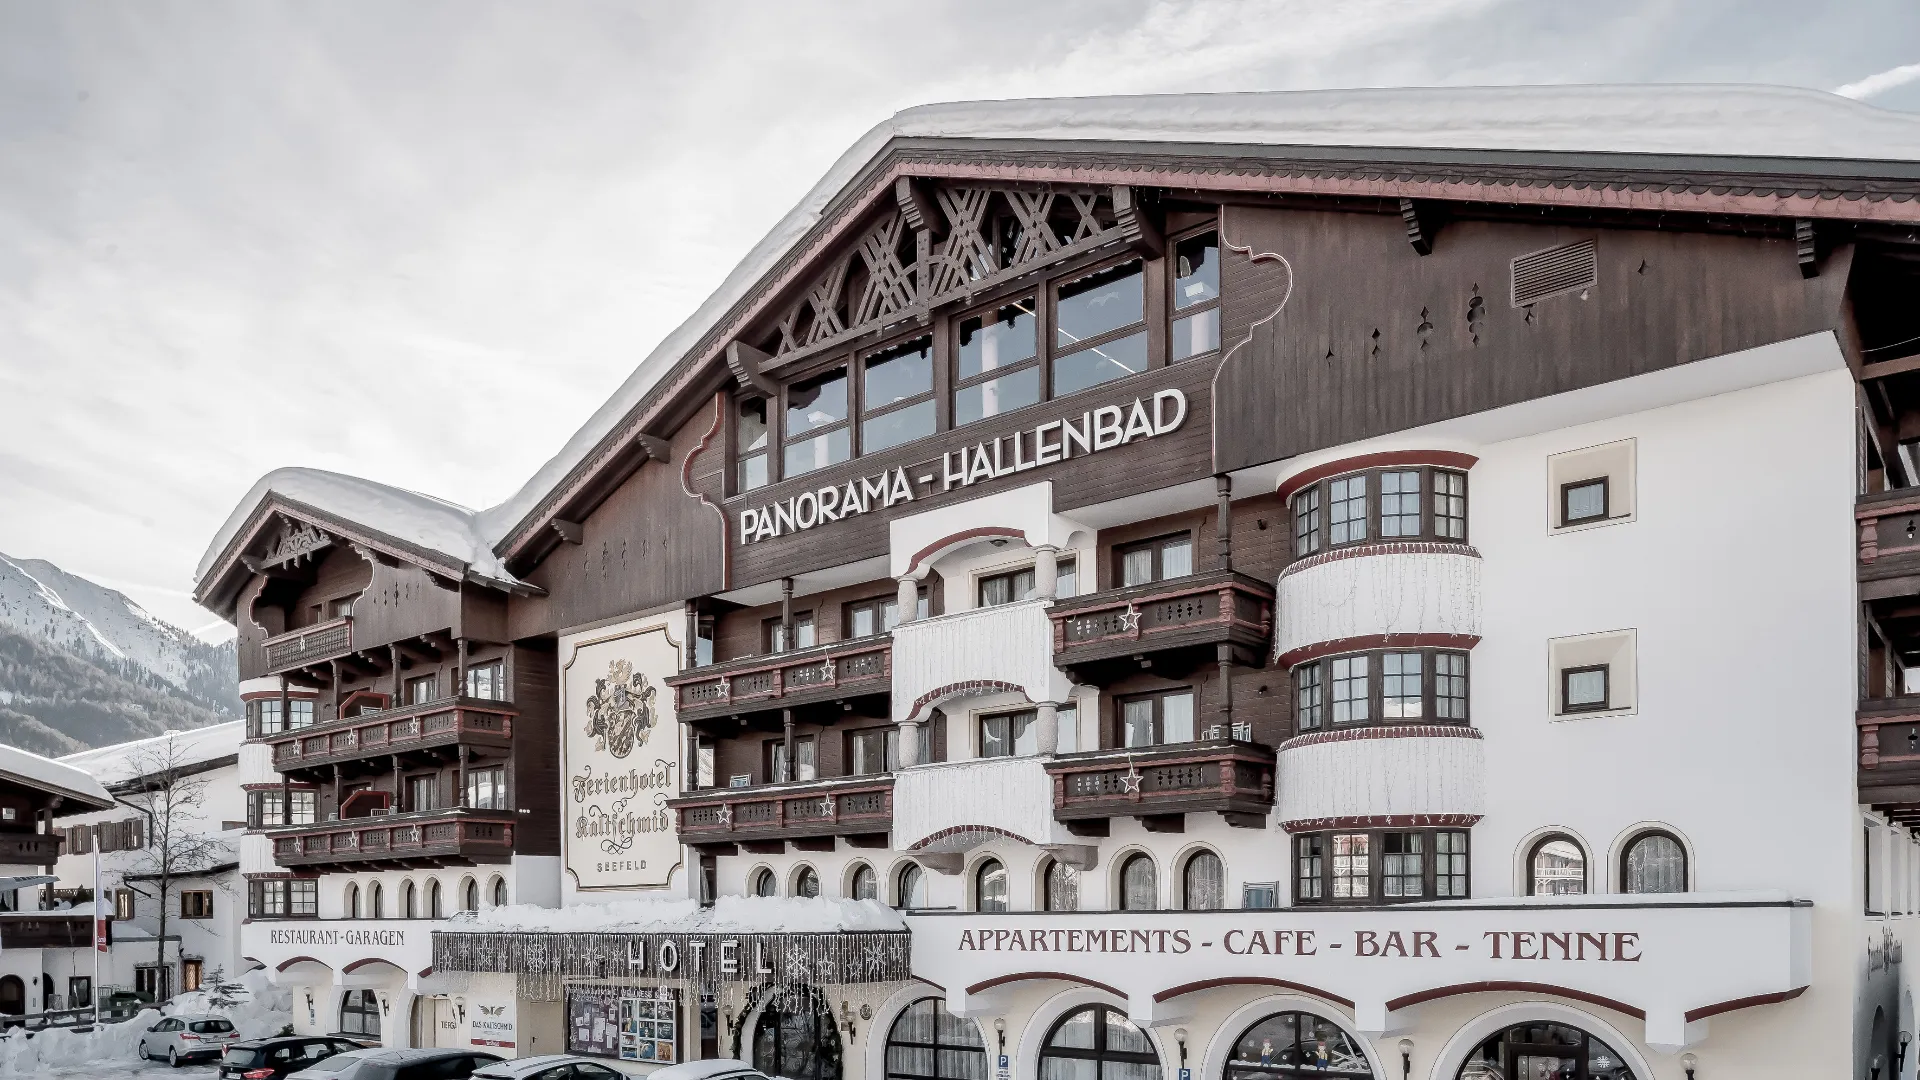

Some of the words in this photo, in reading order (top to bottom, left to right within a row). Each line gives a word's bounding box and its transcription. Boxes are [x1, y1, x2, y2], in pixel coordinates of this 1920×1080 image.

[740, 465, 914, 545] PANORAMA
[943, 388, 1188, 491] HALLENBAD
[572, 759, 676, 807] Ferienhotel
[597, 860, 647, 873] SEEFELD
[627, 939, 772, 974] HOTEL
[958, 929, 1192, 954] APPARTEMENTS
[1223, 929, 1318, 956] CAFE
[1354, 930, 1442, 958] BAR
[1483, 931, 1643, 962] TENNE
[483, 1021, 513, 1031] KALTSCHMID
[1000, 1056, 1007, 1066] P
